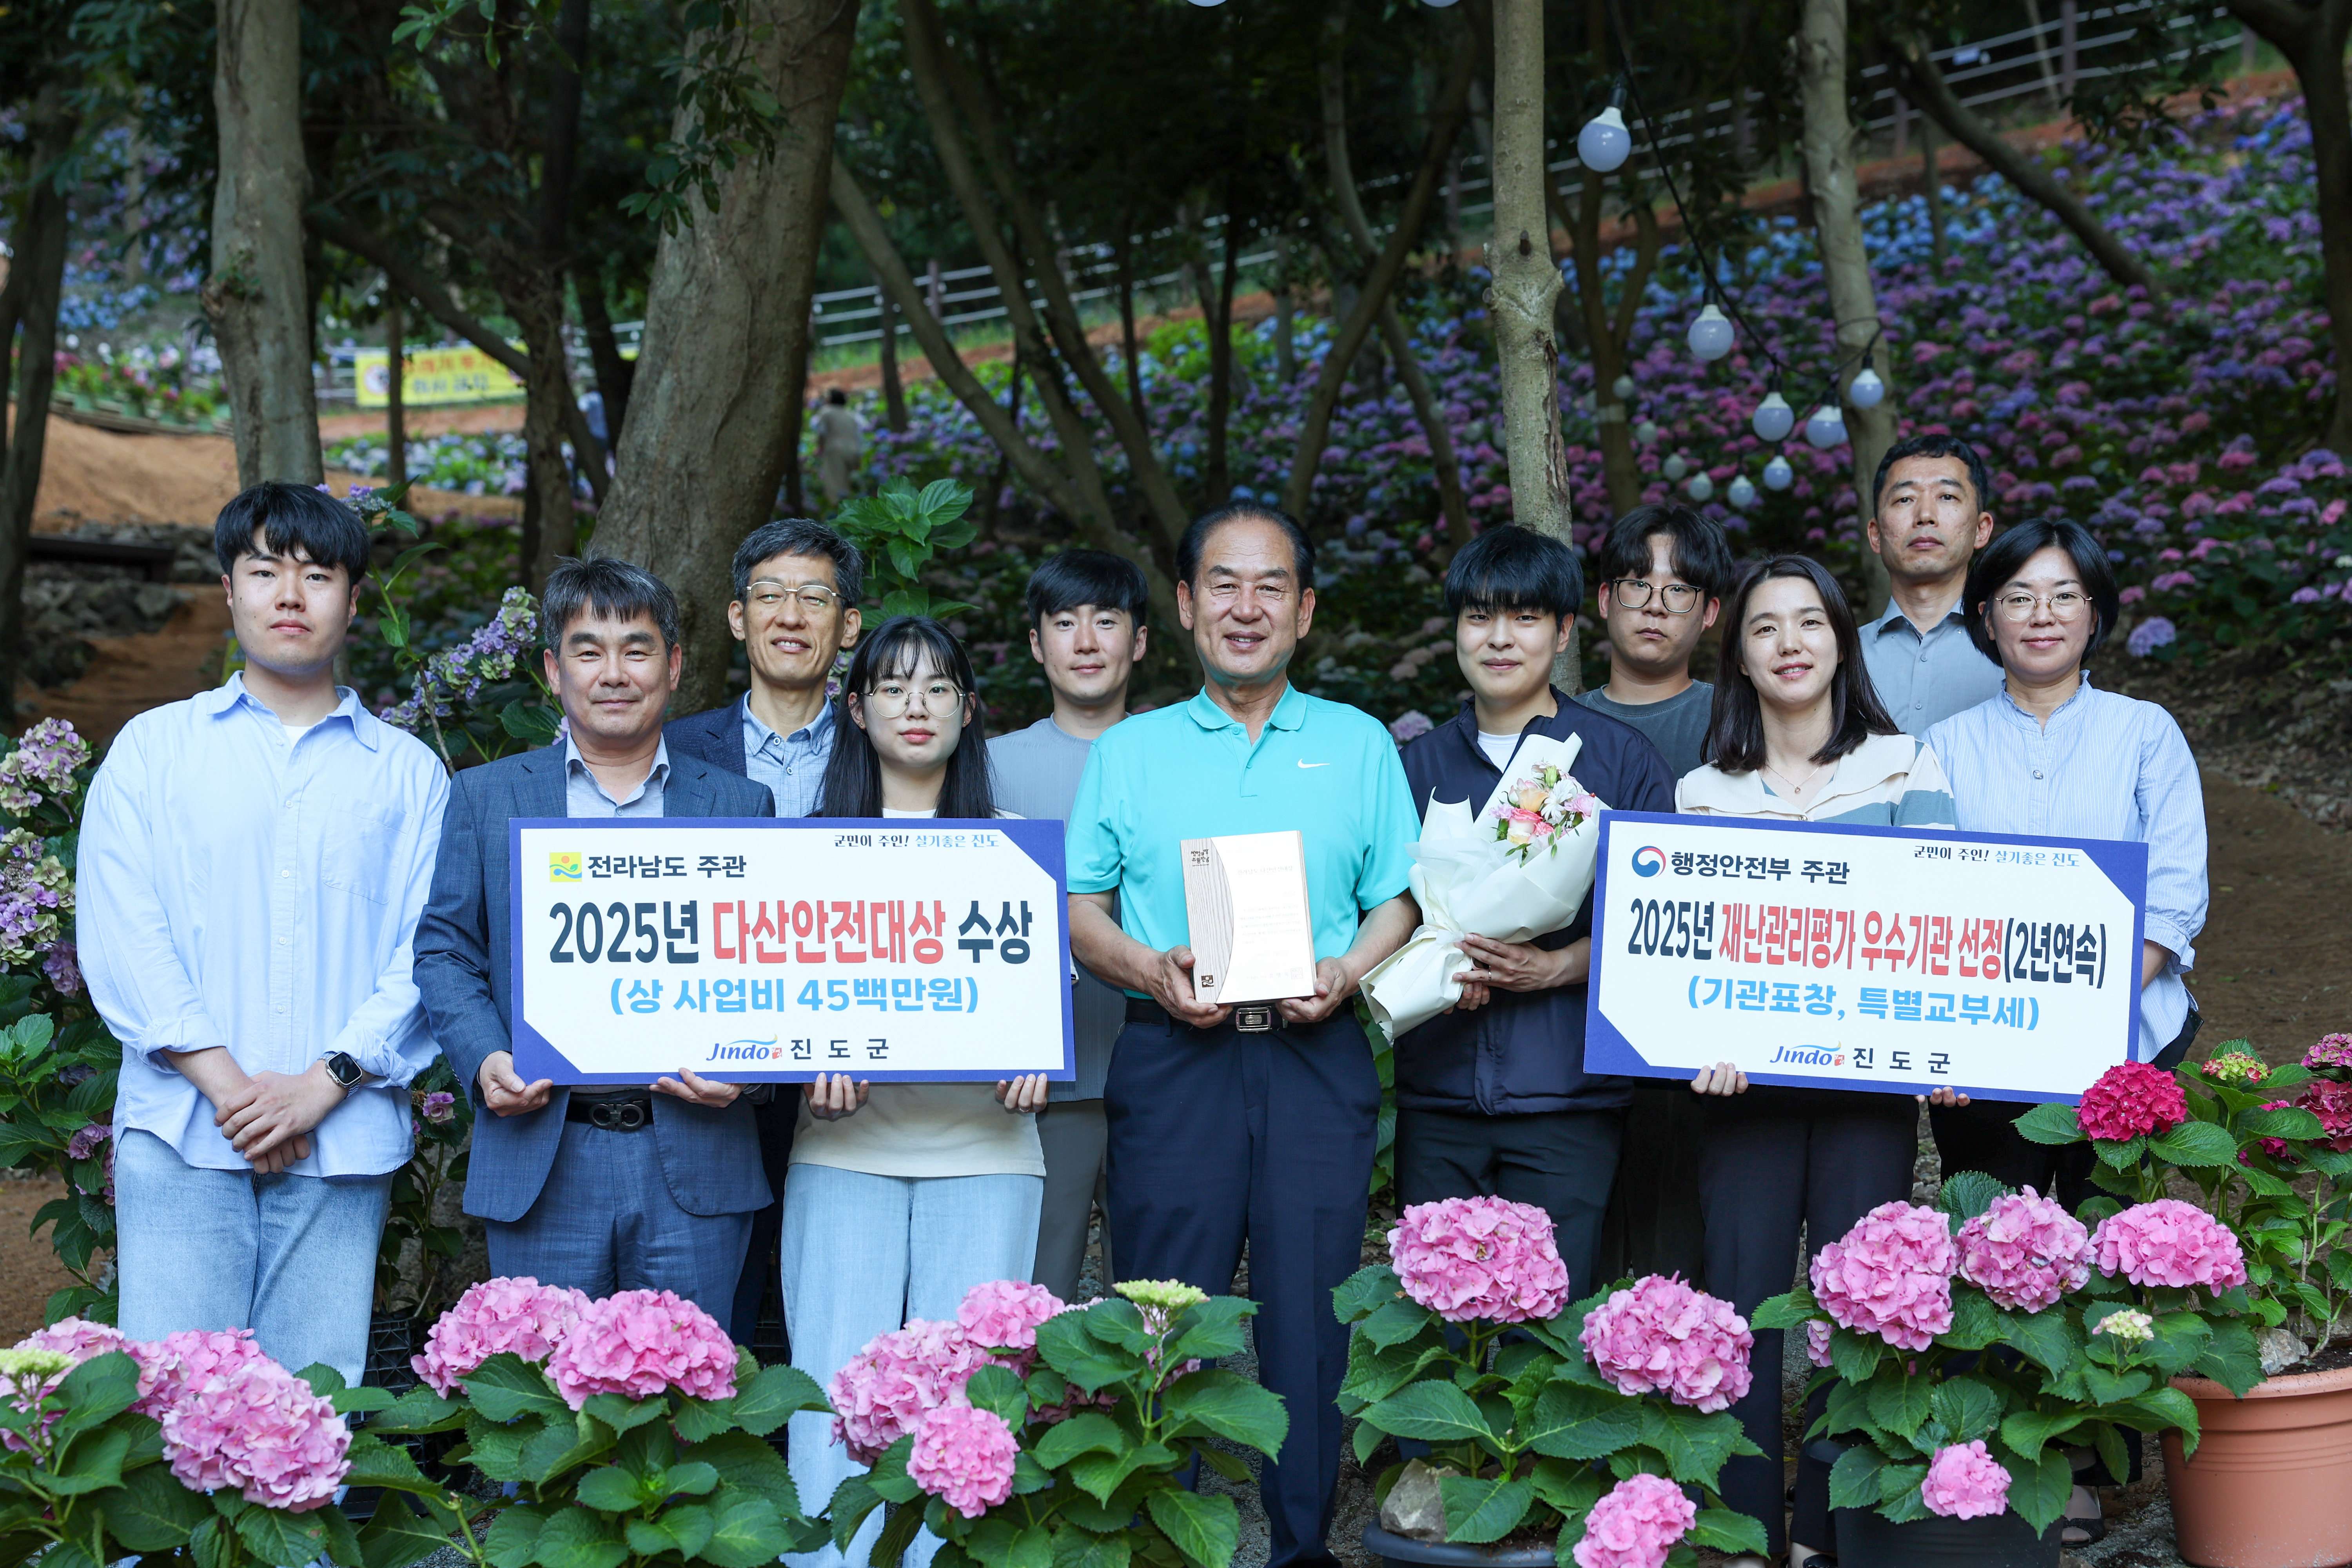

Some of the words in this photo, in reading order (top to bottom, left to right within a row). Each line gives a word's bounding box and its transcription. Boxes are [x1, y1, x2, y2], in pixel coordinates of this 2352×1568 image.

[834, 835, 872, 847] 군민이
[878, 835, 909, 847] 주인!
[915, 835, 966, 848] 살기좋은
[971, 834, 999, 848] 진도
[587, 855, 687, 878] 전라남도
[697, 855, 747, 878] 주관
[1671, 851, 1791, 881] 행정안전부
[1800, 860, 1850, 885] 주관
[1914, 846, 1951, 860] 군민이
[1957, 848, 1989, 862] 주인!
[1994, 850, 2046, 866] 살기좋은
[2051, 853, 2080, 867] 진도
[549, 900, 699, 964] 2025년
[713, 900, 946, 964] 다산안전대상
[958, 900, 1033, 964] 수상
[1628, 898, 1715, 960] 2025년
[1719, 903, 1856, 970] 재난관리평가
[1861, 911, 1953, 976] 우수기관
[1958, 917, 2106, 989] 선정(2년연속)
[611, 978, 663, 1015] (상
[673, 978, 784, 1013] 사업비
[797, 976, 978, 1013] 45백만원)
[1688, 975, 1845, 1021] (기관표창,
[1857, 987, 2039, 1031] 특별교부세)
[706, 1043, 769, 1061] Jindo
[1769, 1046, 1832, 1065] Jindo
